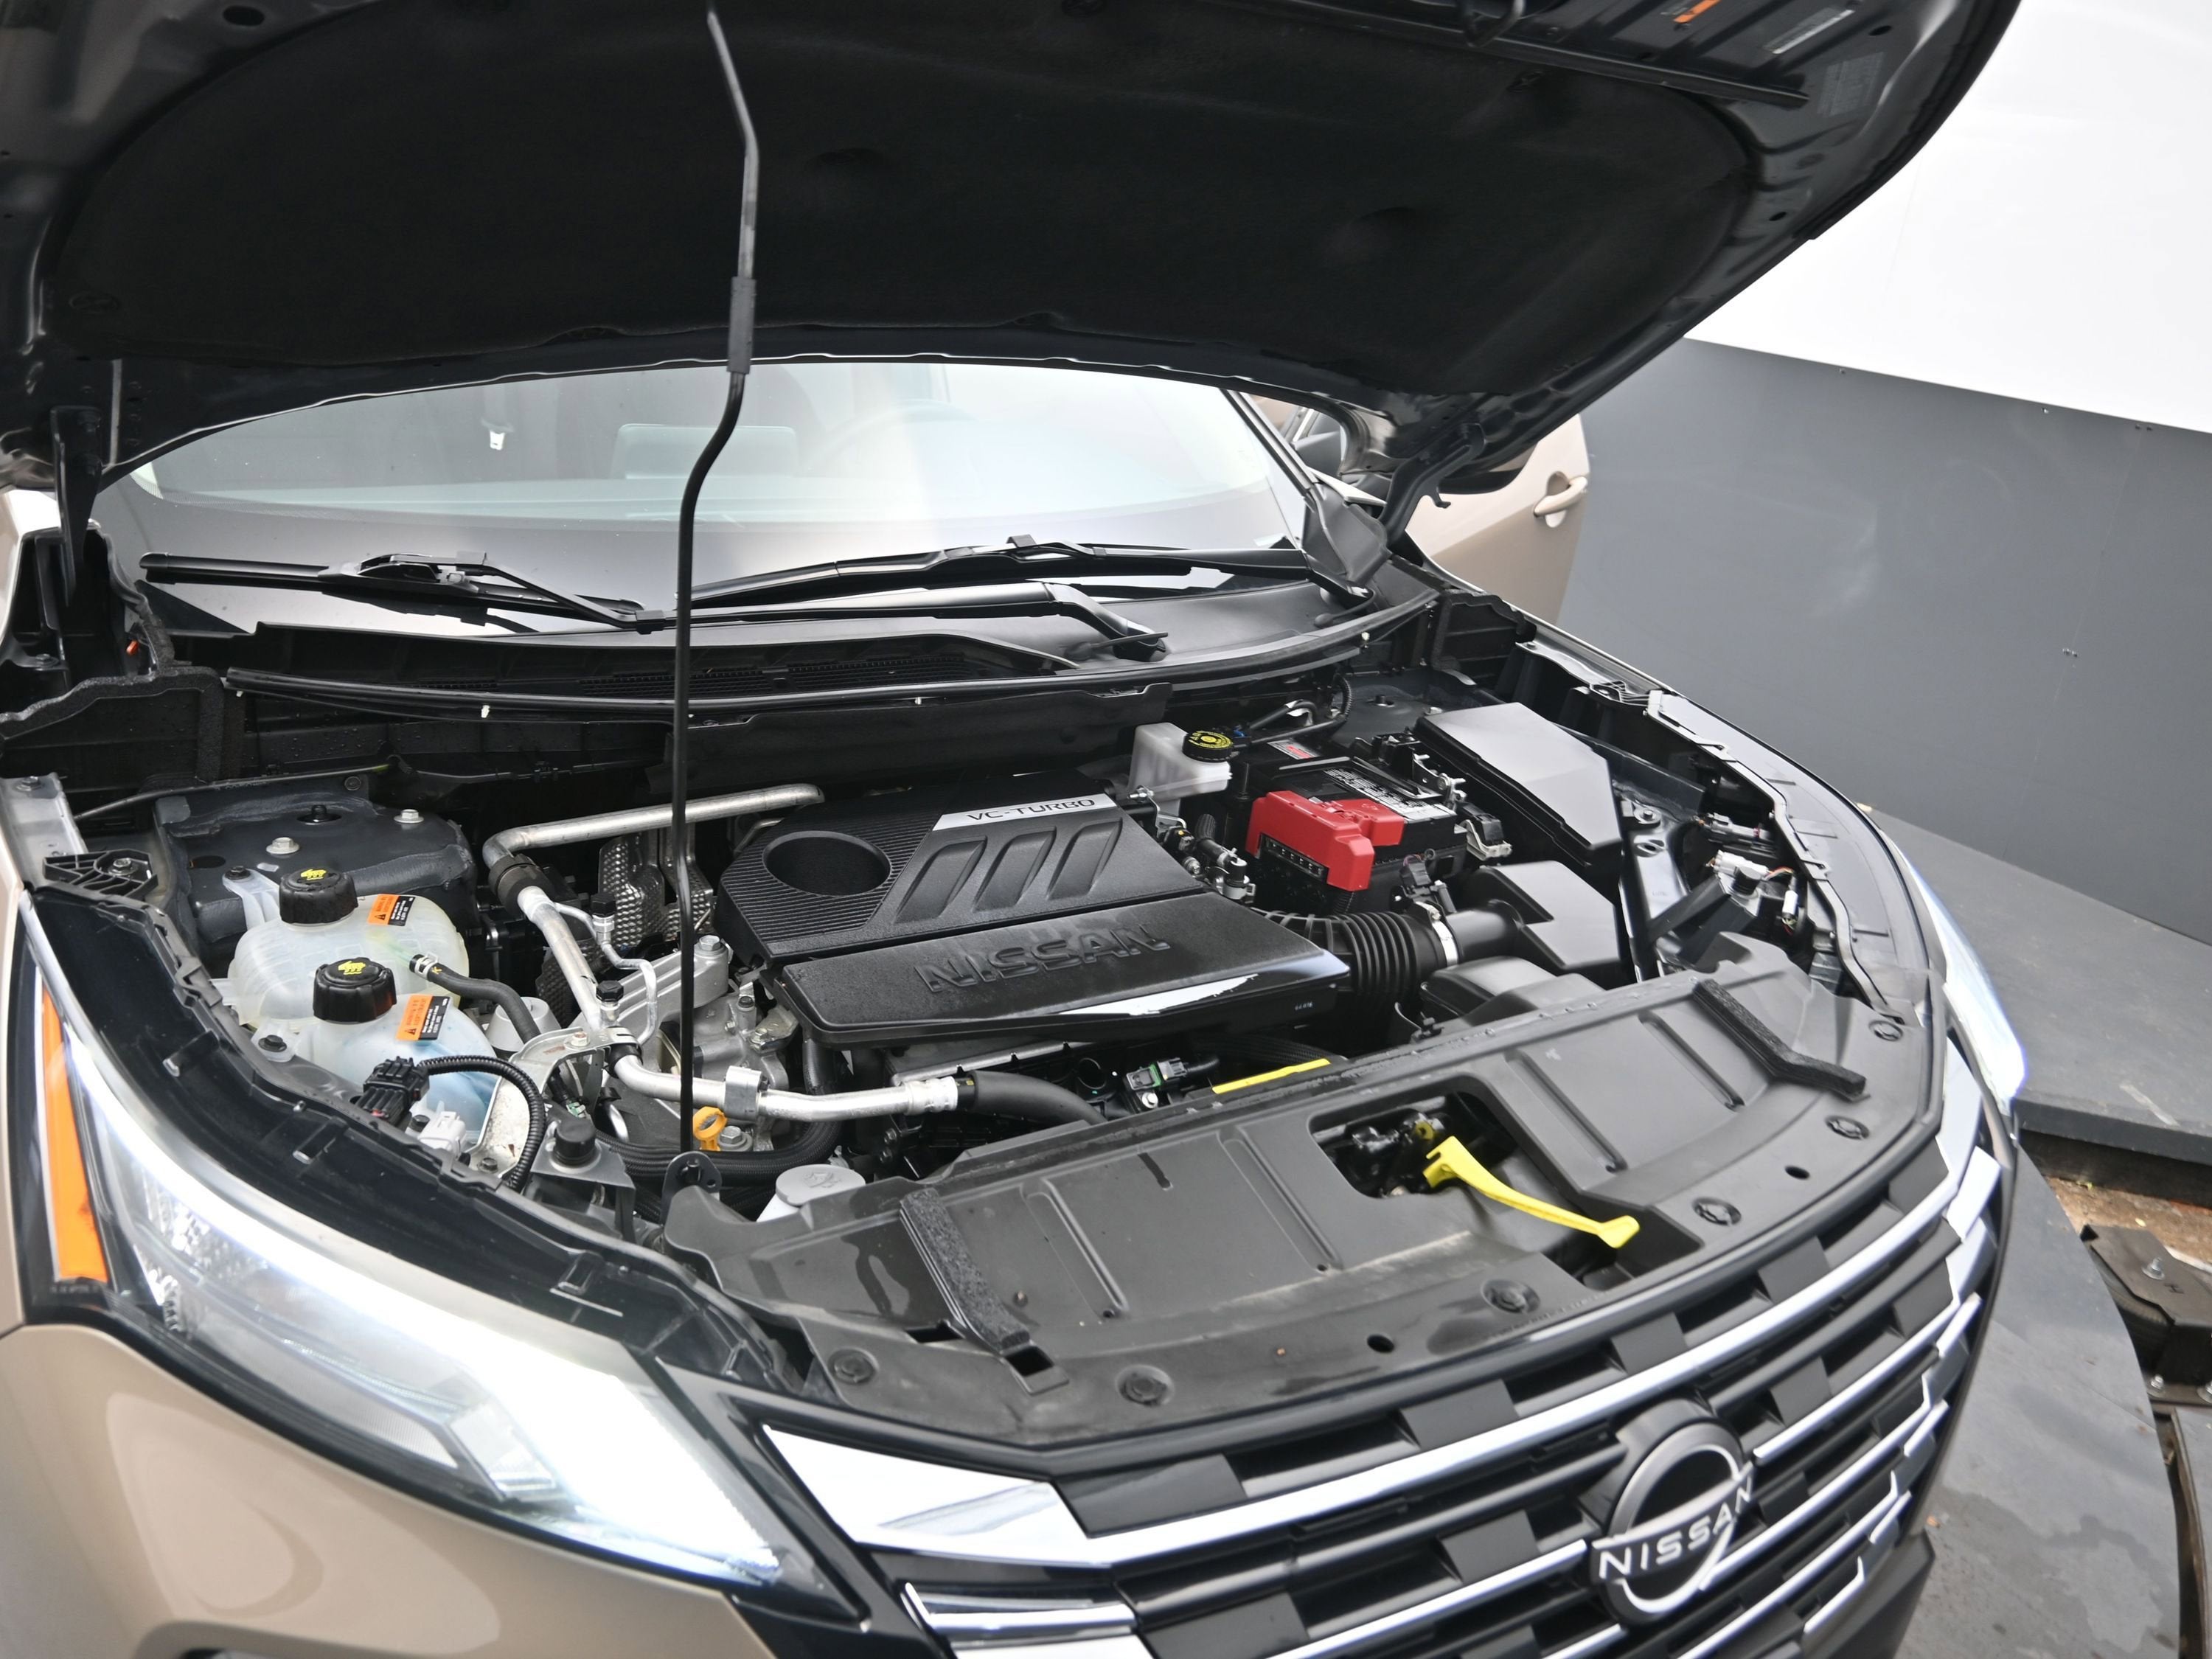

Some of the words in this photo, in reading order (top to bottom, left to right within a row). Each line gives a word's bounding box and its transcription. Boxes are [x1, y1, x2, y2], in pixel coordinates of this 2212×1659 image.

[967, 798, 1096, 821] VC-TURBO
[914, 925, 1171, 992] NISSAN
[1599, 1475, 1753, 1579] NISSAN
